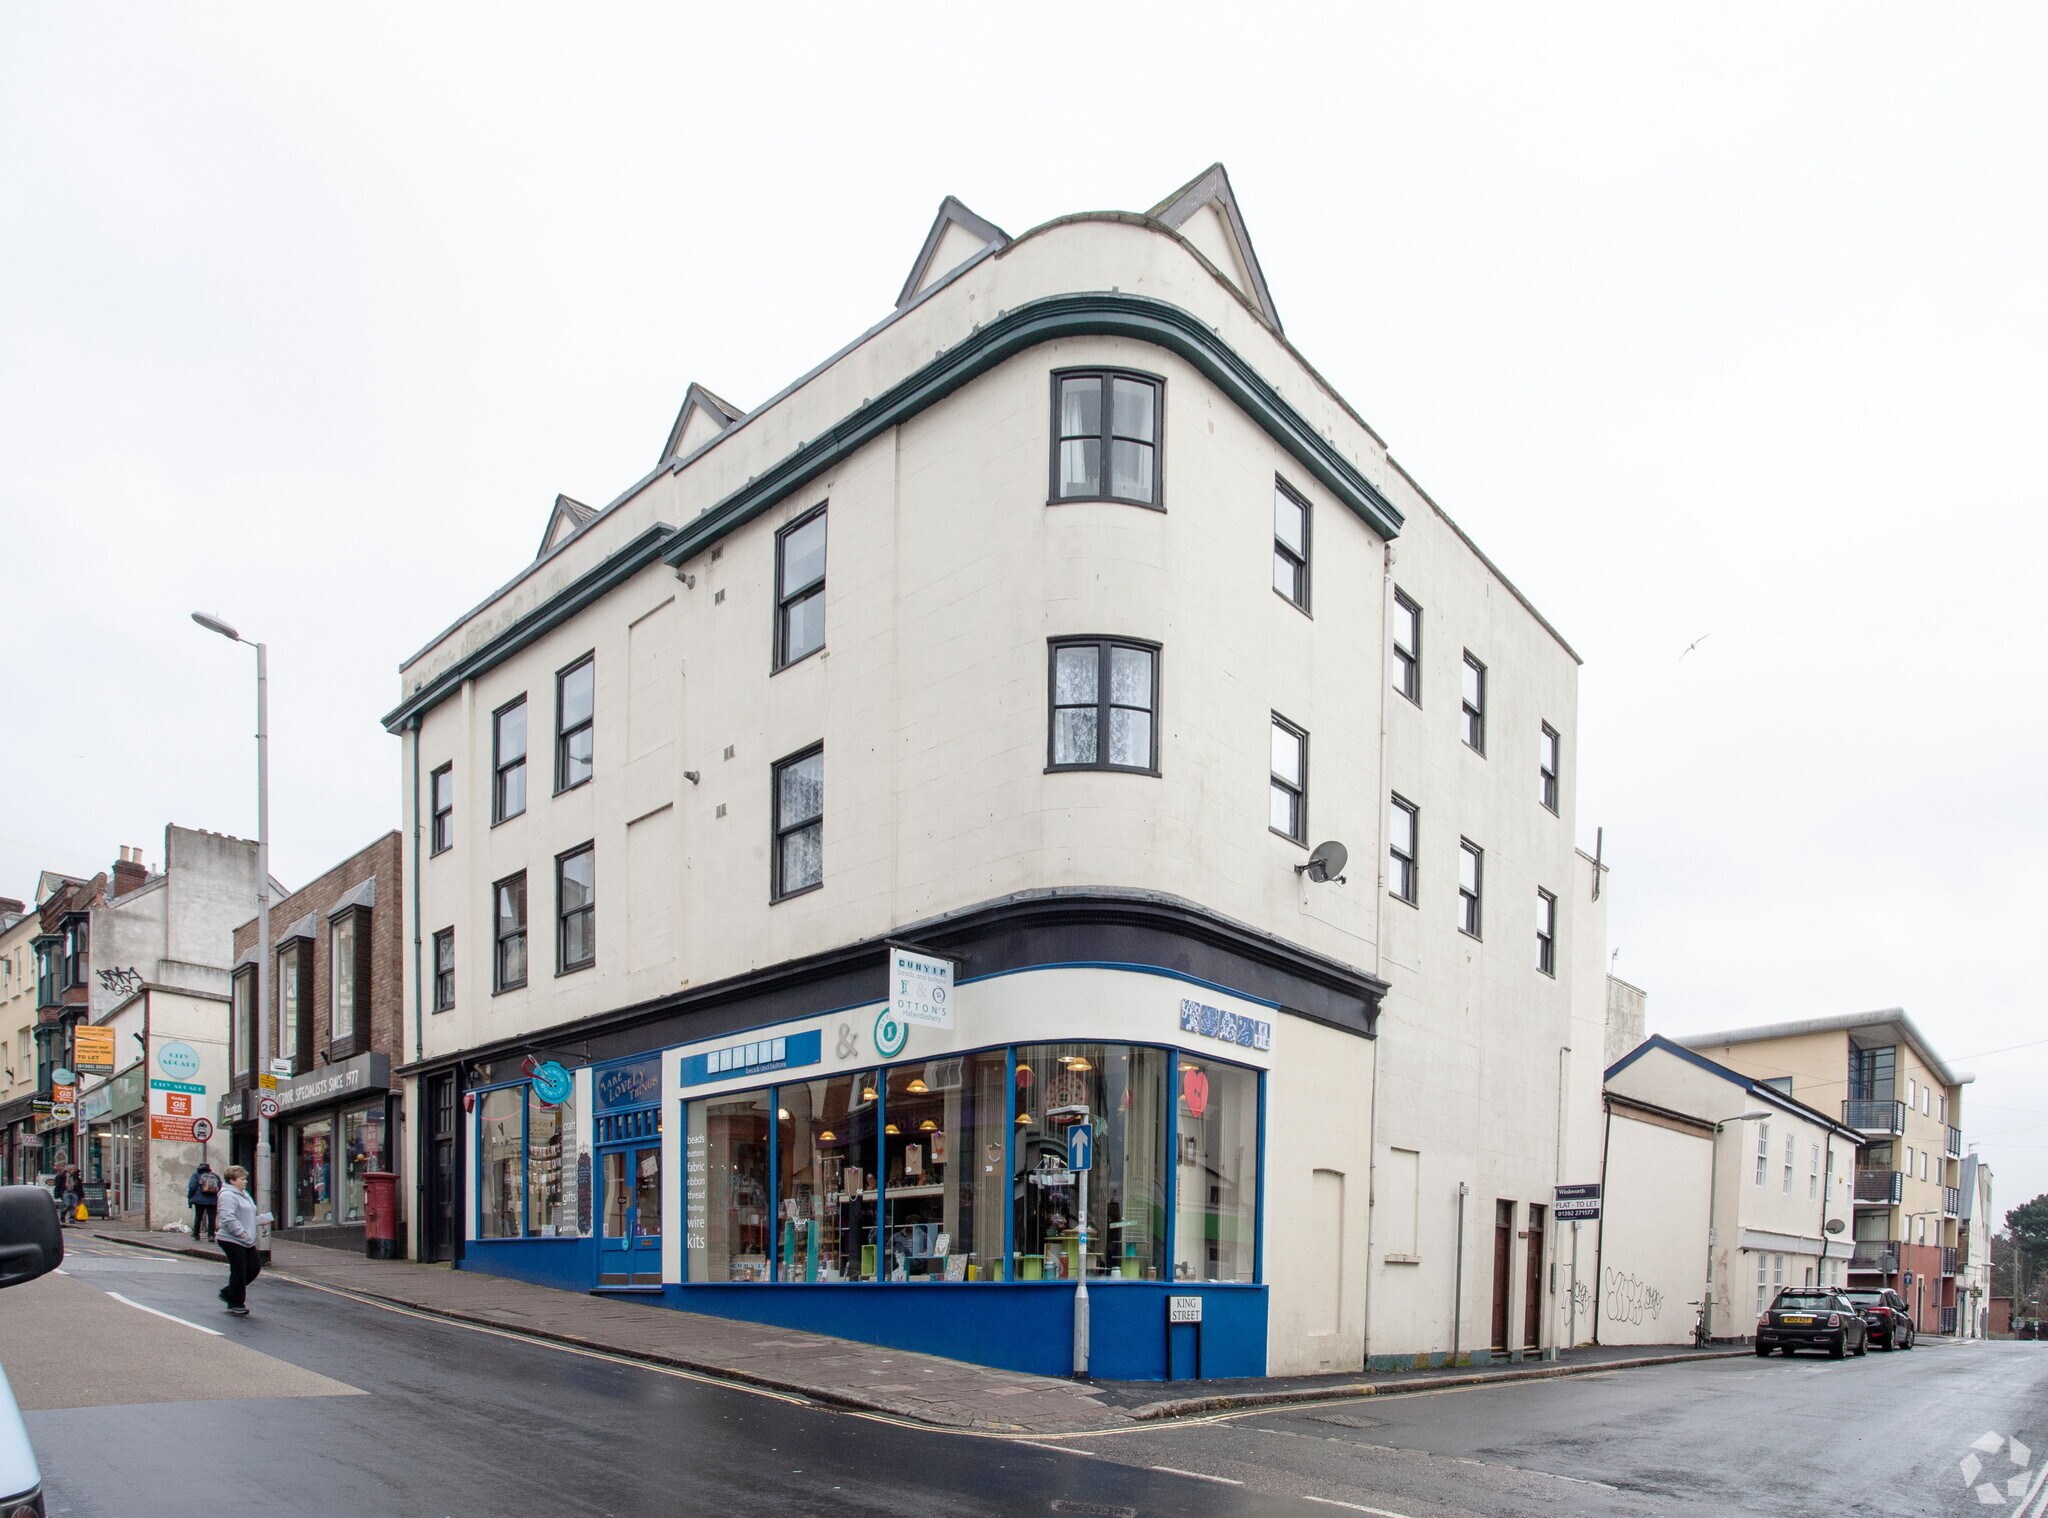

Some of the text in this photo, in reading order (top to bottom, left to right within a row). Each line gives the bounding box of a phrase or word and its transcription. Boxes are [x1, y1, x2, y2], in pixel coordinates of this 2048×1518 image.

[898, 959, 947, 976] BUNYIP
[898, 968, 946, 984] beads and buttons
[898, 1000, 947, 1017] OTTON'S
[903, 1010, 941, 1024] Haberdashery
[295, 1079, 327, 1102] SPECIALISTS
[328, 1073, 344, 1092] SINCE
[345, 1069, 359, 1088] 1977
[601, 1072, 622, 1092] MAKE
[609, 1069, 645, 1103] LOVELY
[629, 1076, 658, 1101] THINGS
[262, 1104, 276, 1112] 20
[563, 1118, 576, 1131] craft
[686, 1134, 705, 1145] beads
[686, 1149, 705, 1158] buttons
[686, 1162, 705, 1172] fabric
[686, 1177, 706, 1187] ribbon
[562, 1190, 577, 1206] gifts
[687, 1190, 706, 1200] thread
[686, 1204, 705, 1214] findings
[1556, 1201, 1571, 1209] FLAT
[1586, 1200, 1598, 1208] LET
[687, 1216, 705, 1229] wire
[686, 1233, 705, 1249] kits
[1176, 1298, 1196, 1308] KING
[1172, 1310, 1200, 1320] STREET
